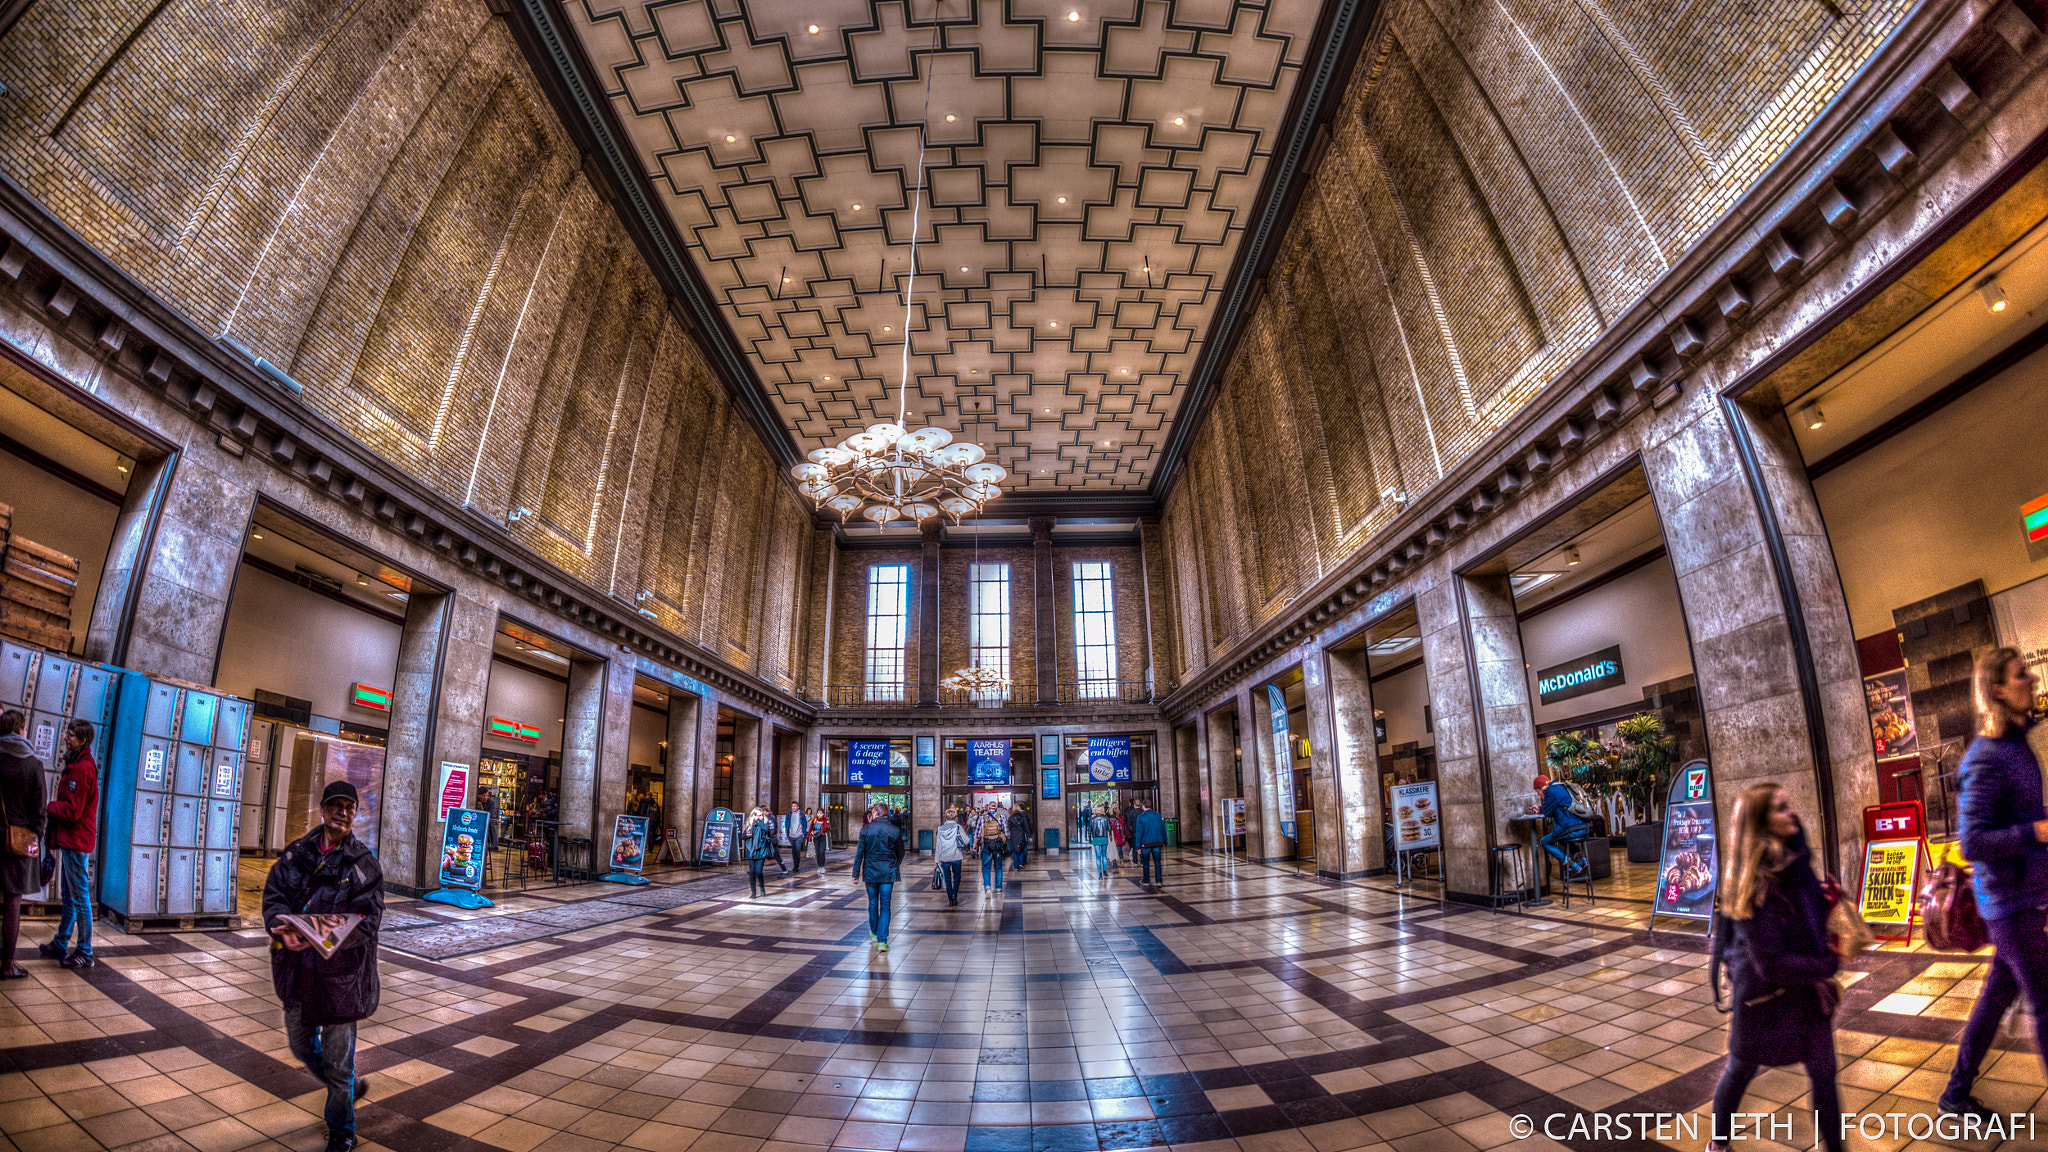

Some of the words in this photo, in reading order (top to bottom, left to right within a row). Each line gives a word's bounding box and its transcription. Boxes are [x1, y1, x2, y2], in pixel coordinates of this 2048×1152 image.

[1539, 660, 1617, 695] McDonald's
[1090, 739, 1126, 749] Billigere
[862, 750, 883, 759] dage
[1106, 748, 1129, 758] biffen
[866, 759, 886, 767] ugen
[850, 771, 864, 780] at
[1116, 767, 1129, 778] at
[1399, 786, 1430, 794] KLASSIKERE
[1690, 773, 1704, 798] 7
[1876, 817, 1910, 831] BT
[1869, 872, 1906, 886] SKJULTE
[1866, 886, 1894, 902] TRICK
